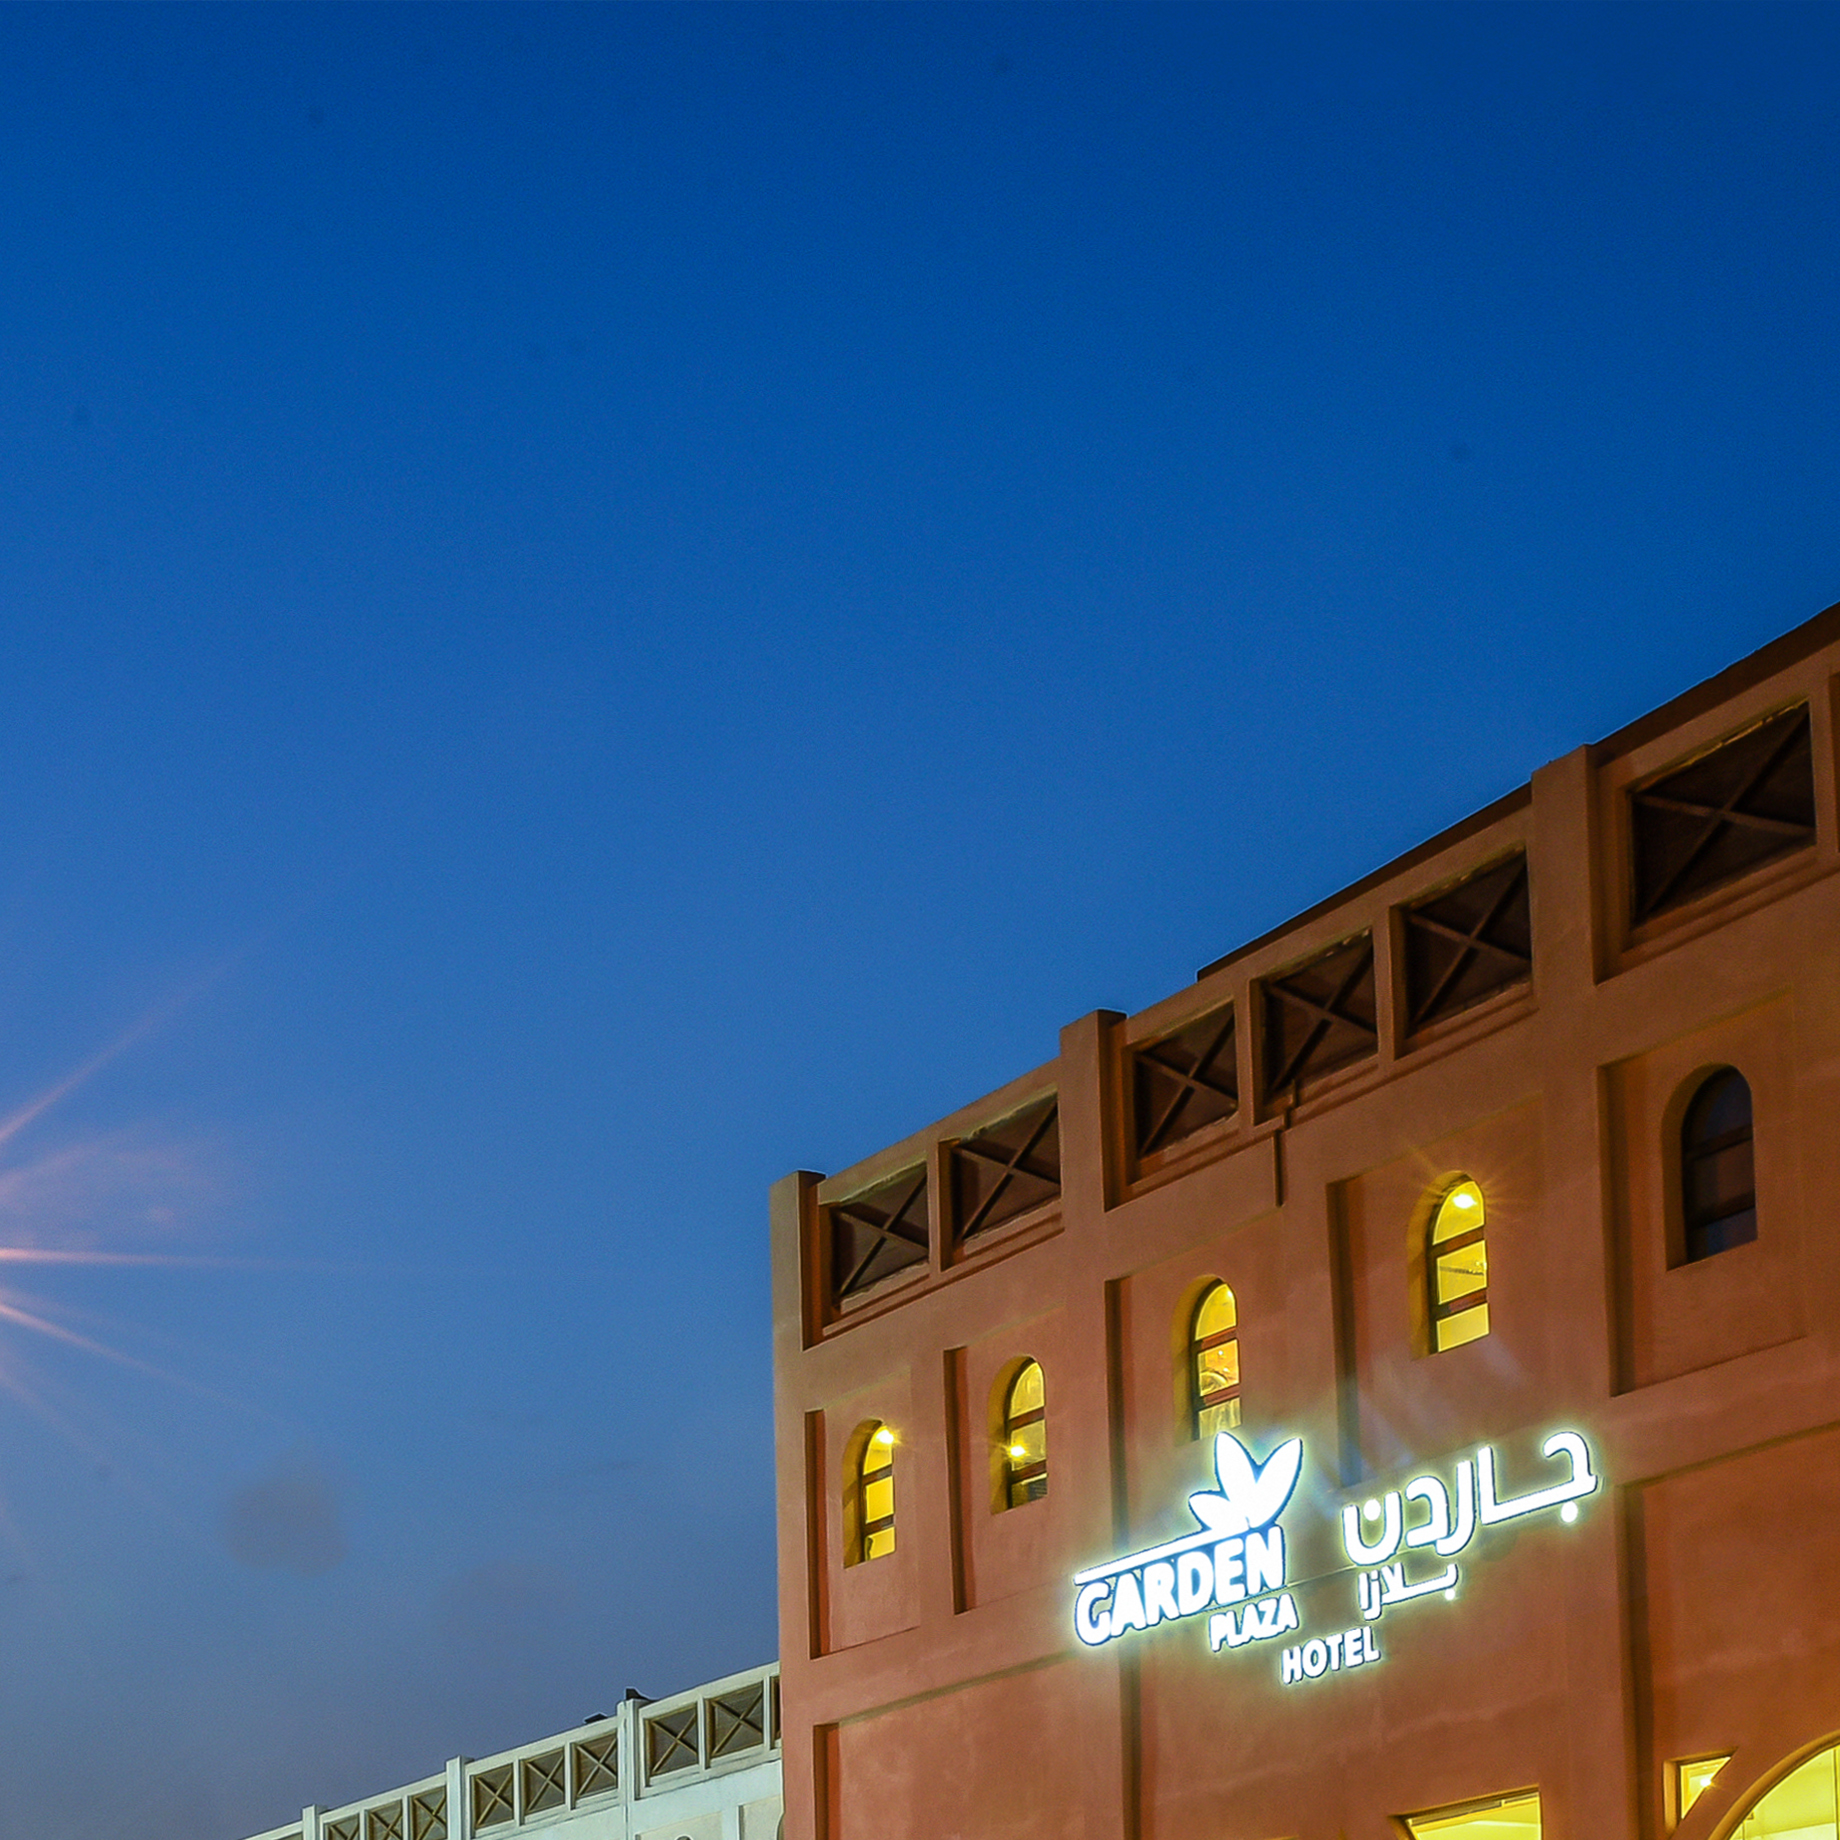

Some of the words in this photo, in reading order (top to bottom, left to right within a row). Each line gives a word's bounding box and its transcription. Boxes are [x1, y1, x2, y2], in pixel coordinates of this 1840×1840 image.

[1343, 1431, 1598, 1567] جاردن
[1075, 1525, 1285, 1646] GARDEN
[1359, 1563, 1459, 1621] بلازا
[1209, 1593, 1299, 1652] PLAZA
[1282, 1627, 1381, 1685] HOTEL
